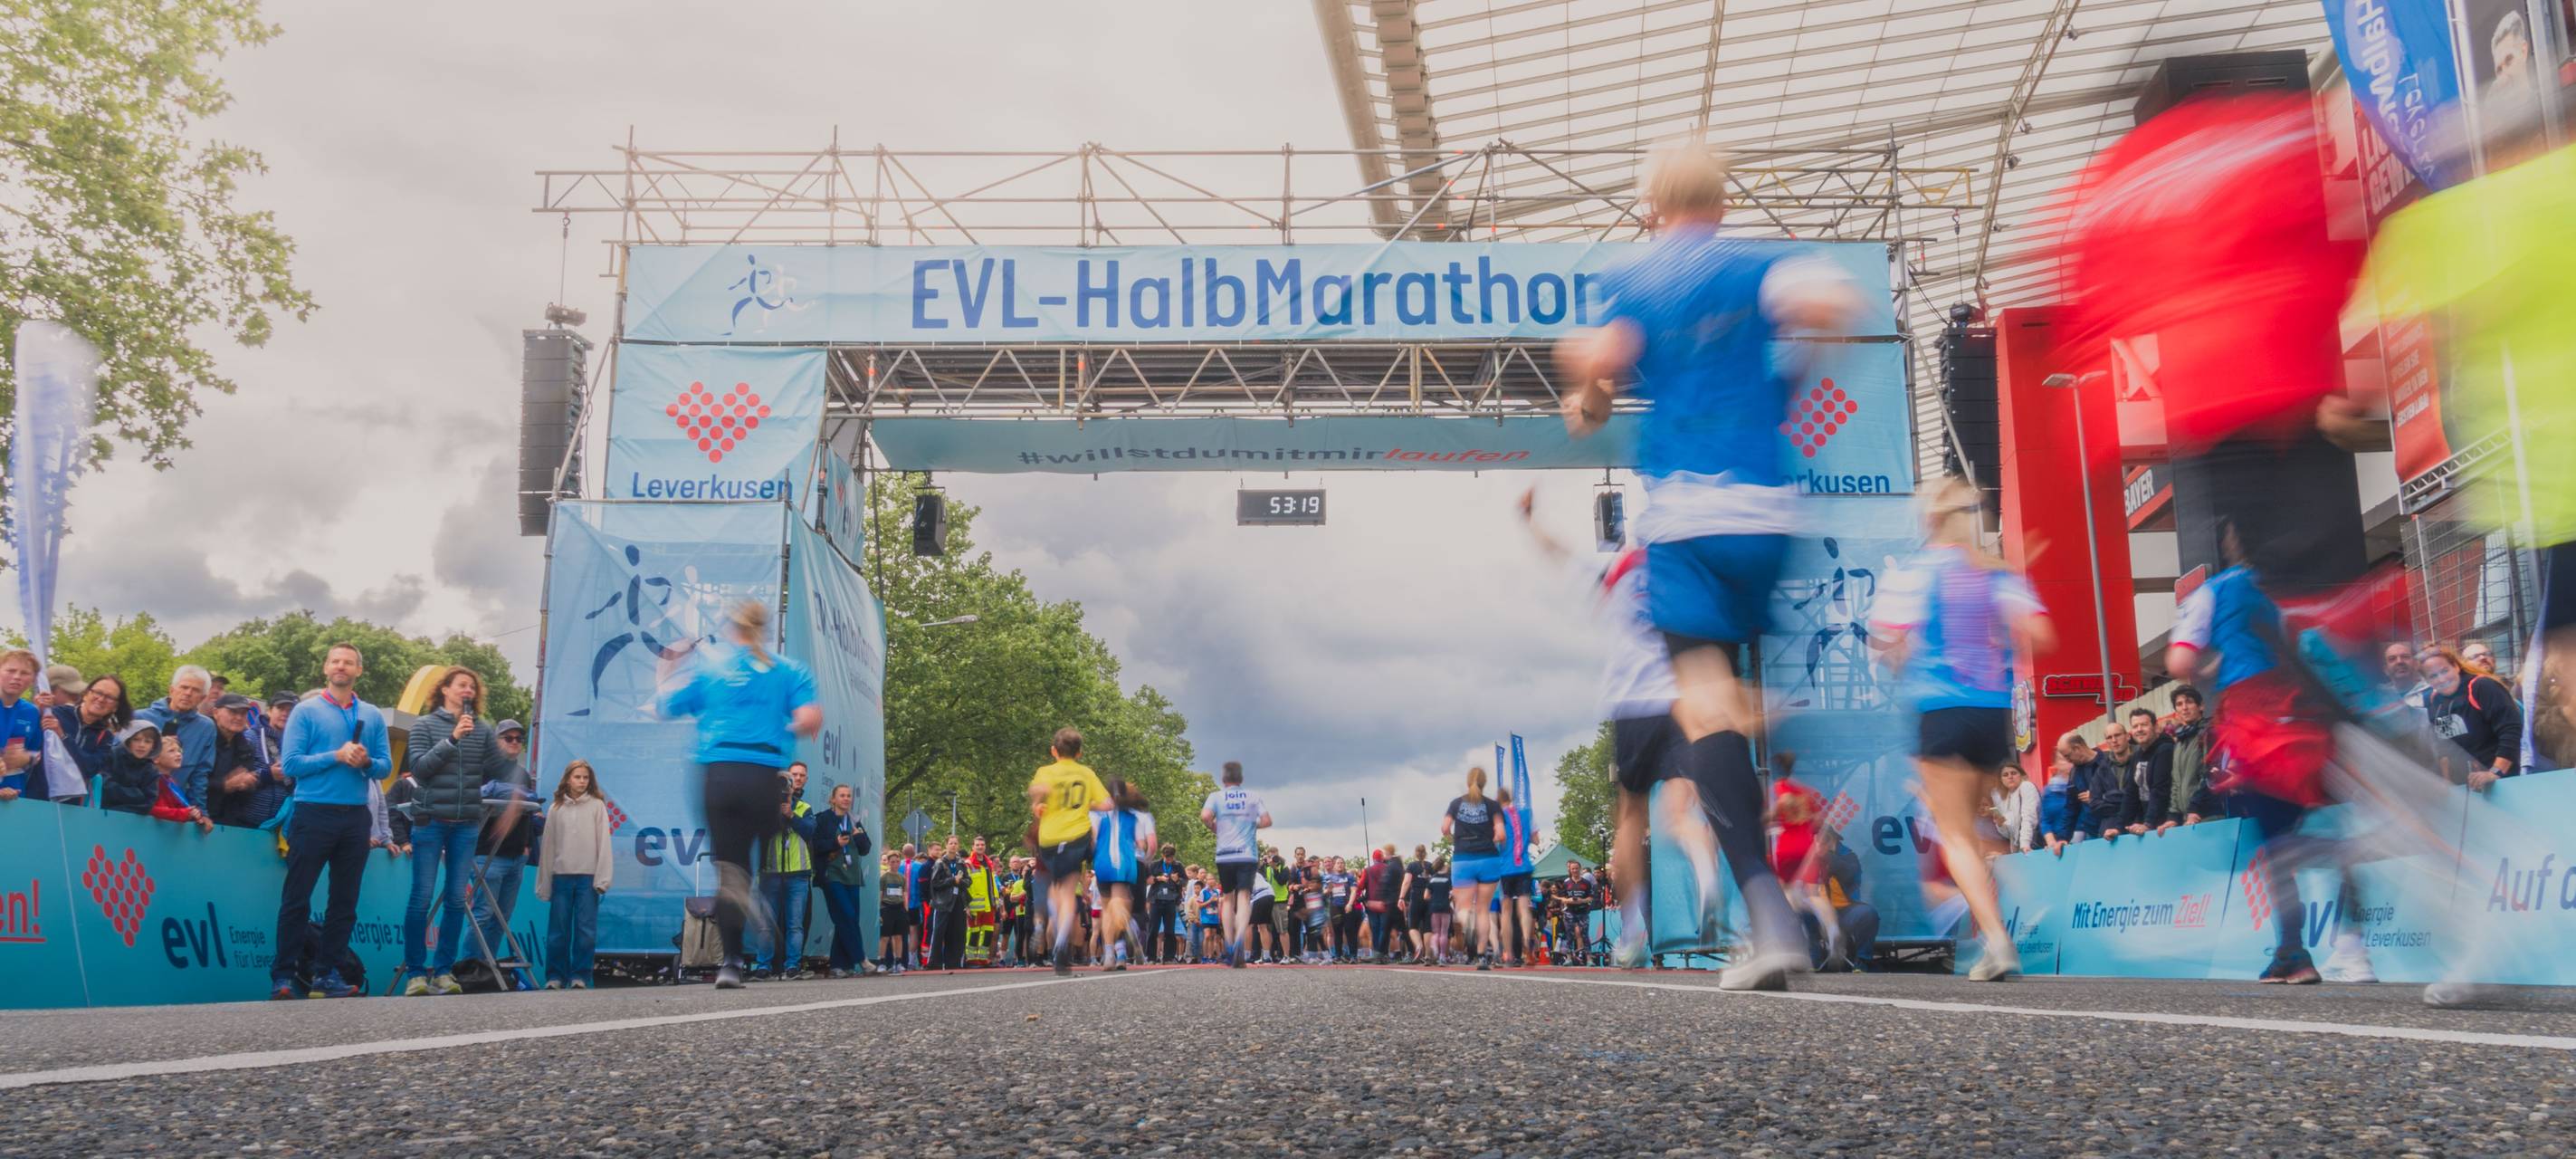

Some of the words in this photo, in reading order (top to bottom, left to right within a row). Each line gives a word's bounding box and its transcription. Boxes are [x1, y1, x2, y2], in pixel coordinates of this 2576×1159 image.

[1017, 446, 1531, 465] #willstdumitmirlaufen
[632, 472, 793, 499] Leverkusen
[2123, 468, 2154, 517] BAYER
[1270, 496, 1320, 513] 53:19
[824, 725, 841, 770] evl
[1225, 790, 1246, 800] join
[1226, 801, 1245, 810] us!
[634, 827, 706, 867] ev
[1872, 816, 1932, 856] ev
[2487, 854, 2556, 912] Auf
[2072, 902, 2092, 929] Mit
[2092, 898, 2140, 933] Energie
[2143, 903, 2173, 926] zum
[2174, 894, 2212, 924] Ziel!
[161, 901, 227, 969] evl
[228, 925, 266, 949] Energie
[349, 916, 393, 951] nergie
[2363, 929, 2432, 949] Leverkusen
